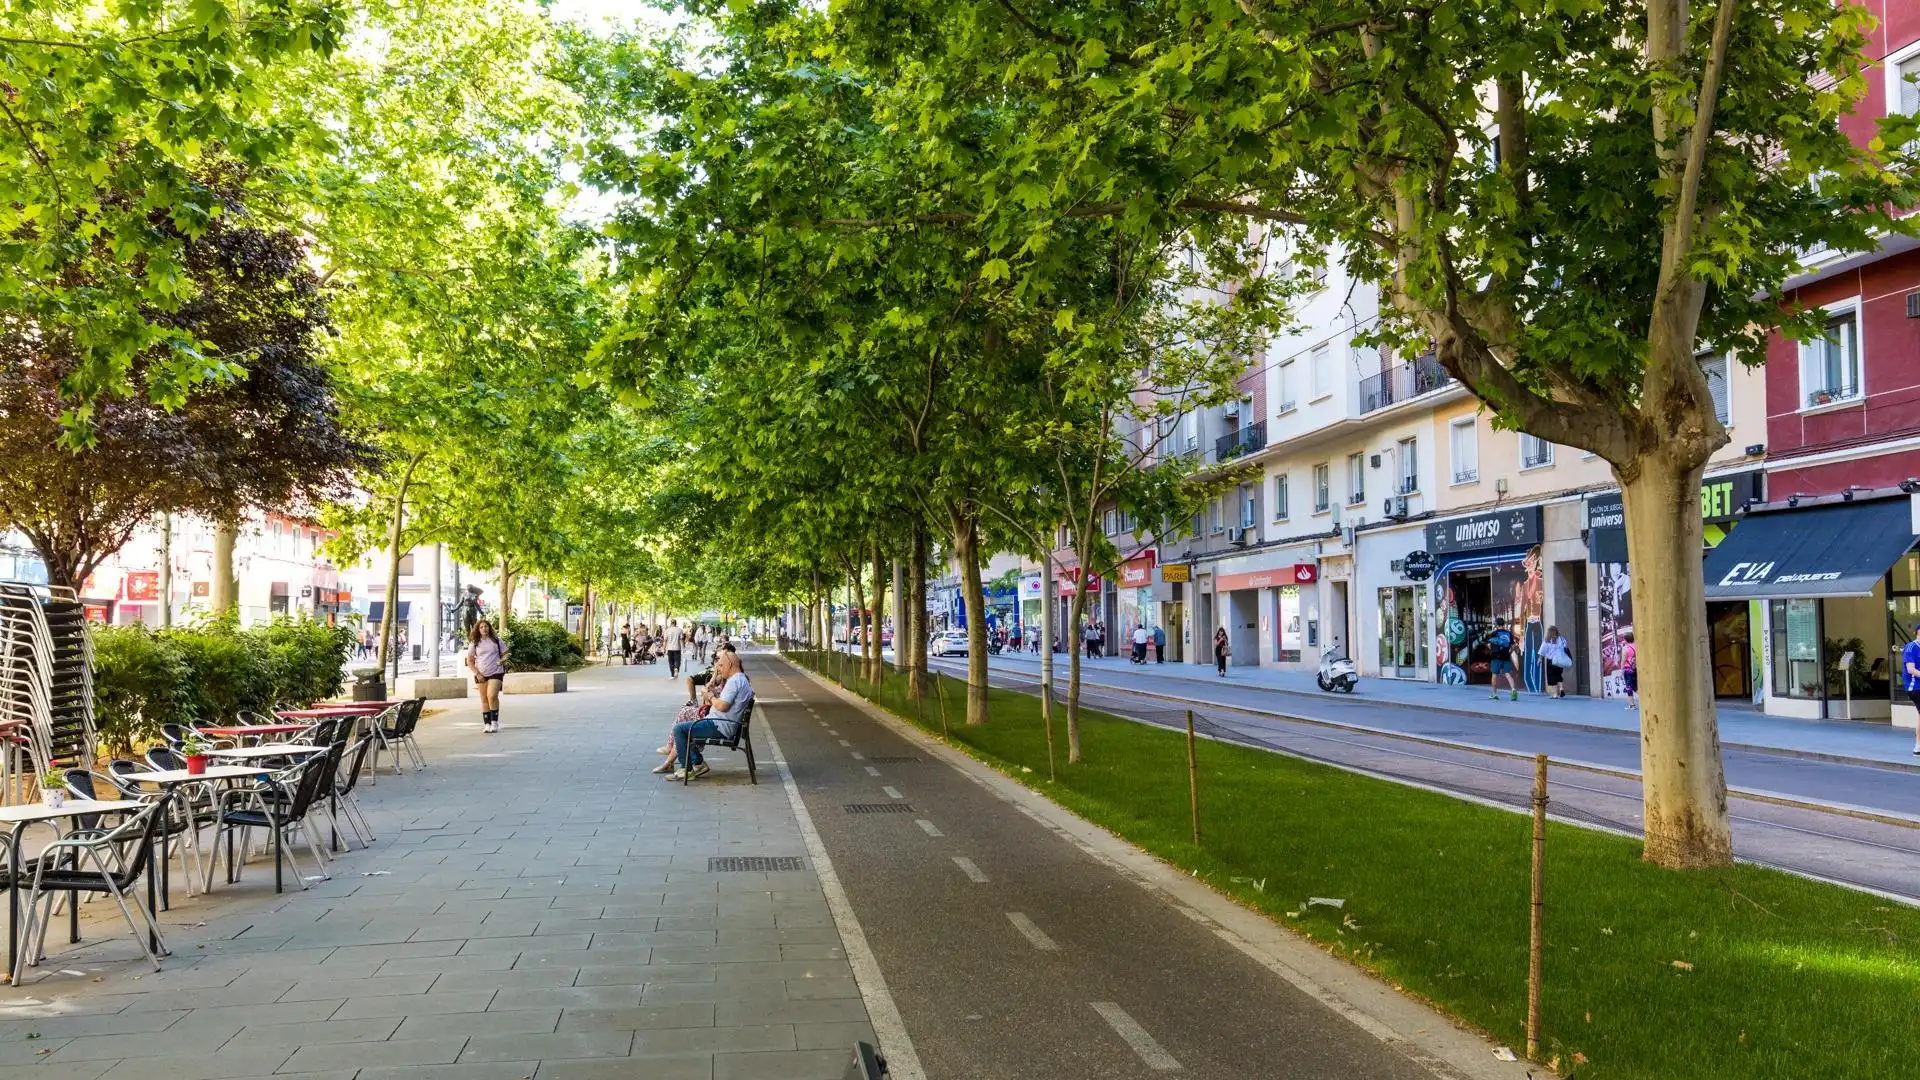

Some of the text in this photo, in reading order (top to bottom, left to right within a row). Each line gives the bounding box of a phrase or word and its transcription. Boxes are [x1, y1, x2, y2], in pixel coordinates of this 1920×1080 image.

[1456, 518, 1500, 542] universo
[1591, 513, 1623, 528] universo
[1718, 561, 1776, 586] EVA
[1773, 571, 1842, 585] peluqueros
